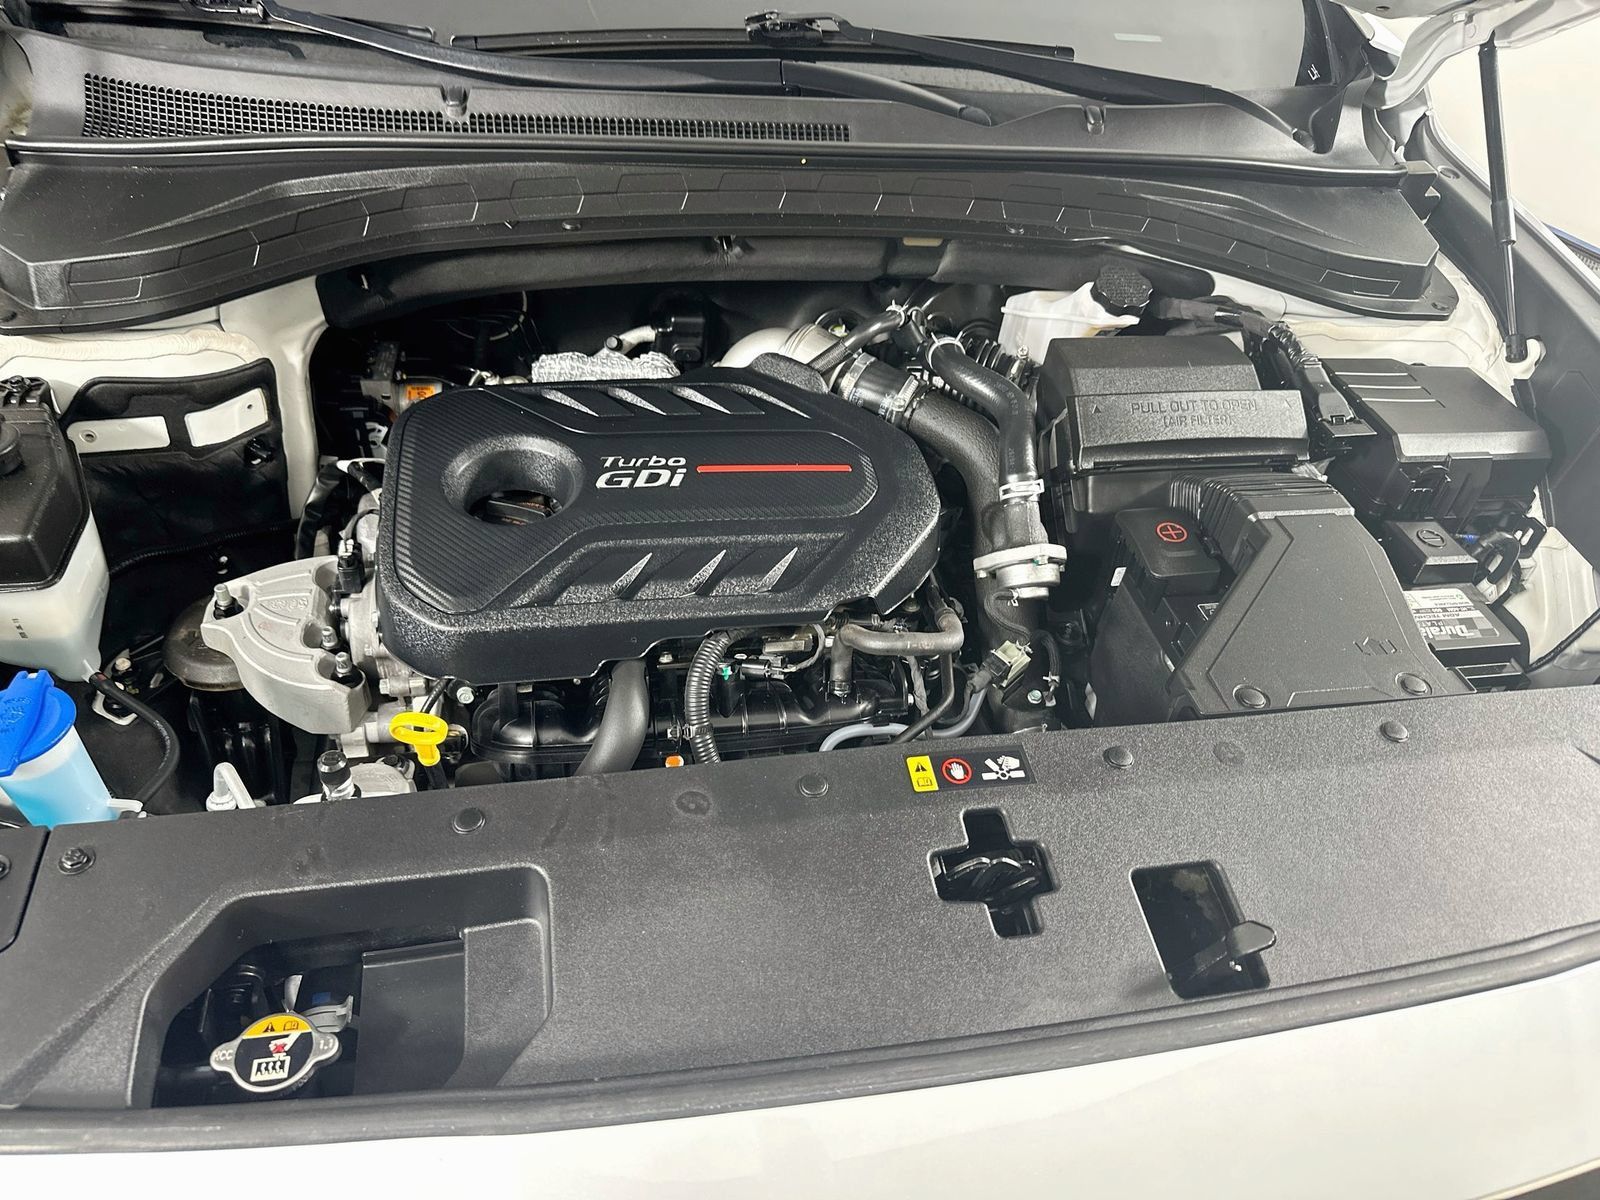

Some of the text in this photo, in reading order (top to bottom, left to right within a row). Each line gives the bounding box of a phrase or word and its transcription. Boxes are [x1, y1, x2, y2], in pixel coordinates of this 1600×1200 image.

[1131, 399, 1258, 415] PULL OUT TO OPEN
[600, 455, 686, 468] Turbo
[595, 468, 687, 489] GDi
